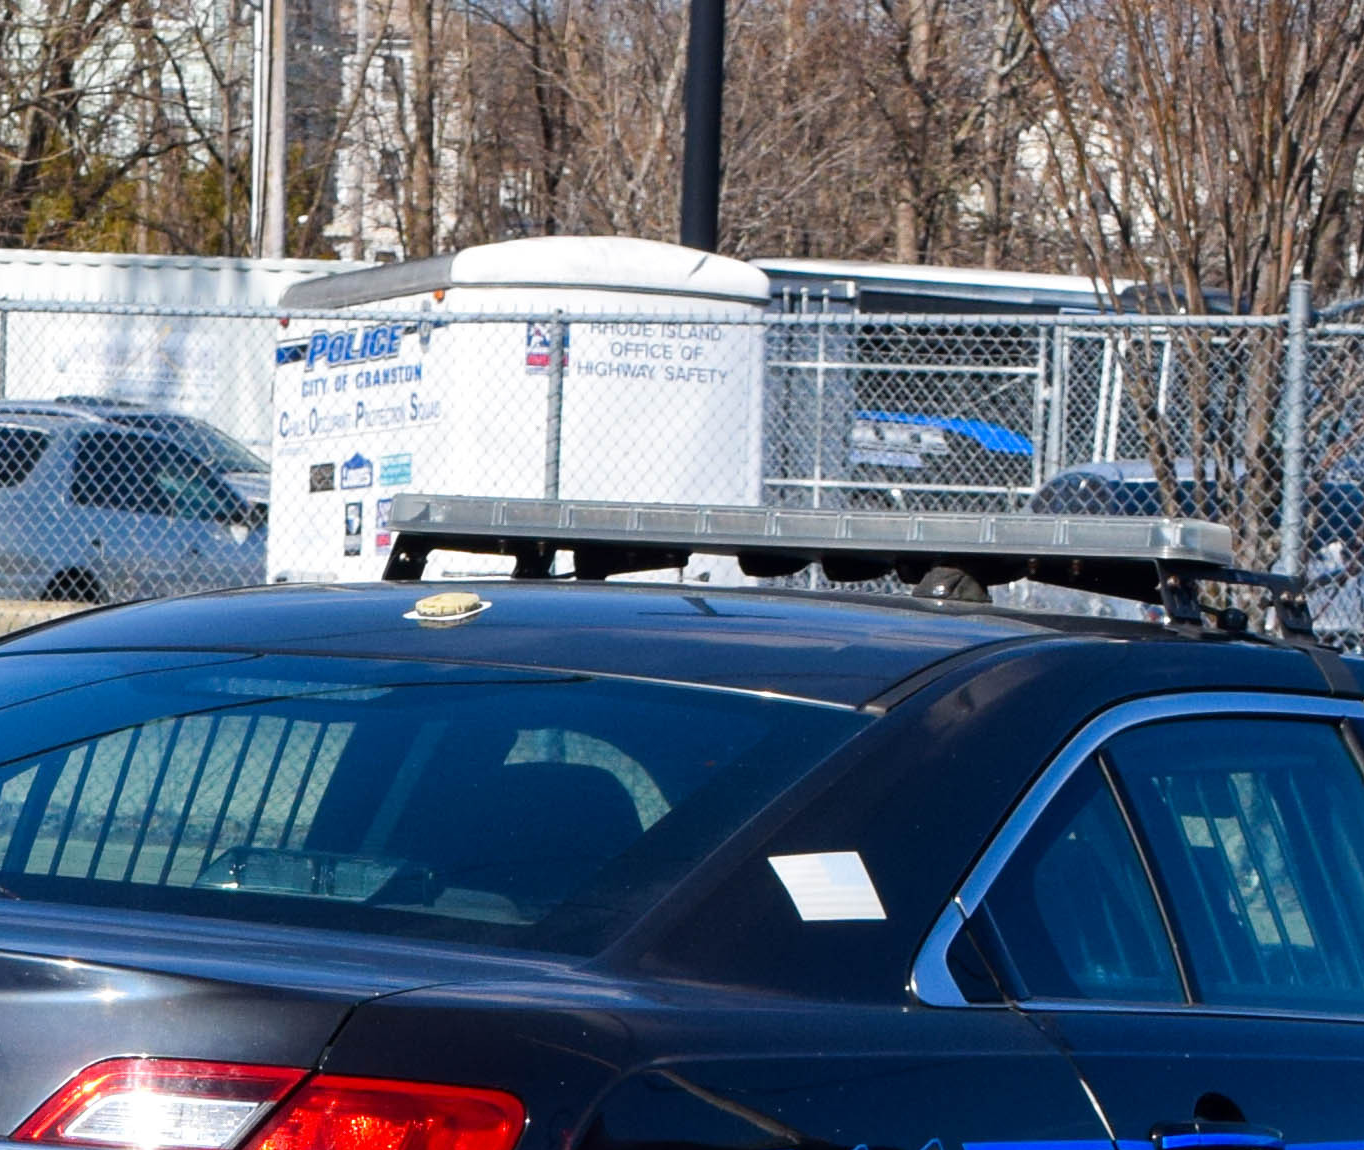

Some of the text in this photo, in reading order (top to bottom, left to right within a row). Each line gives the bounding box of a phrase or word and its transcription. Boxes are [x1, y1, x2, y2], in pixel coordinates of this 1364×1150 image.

[590, 321, 722, 341] RHODE ISLAND
[306, 324, 404, 371] POLICE
[610, 341, 705, 361] OFFICE OF
[301, 363, 422, 398] CITY OF CRANSTON
[577, 361, 728, 384] HIGHWAY SAFETY
